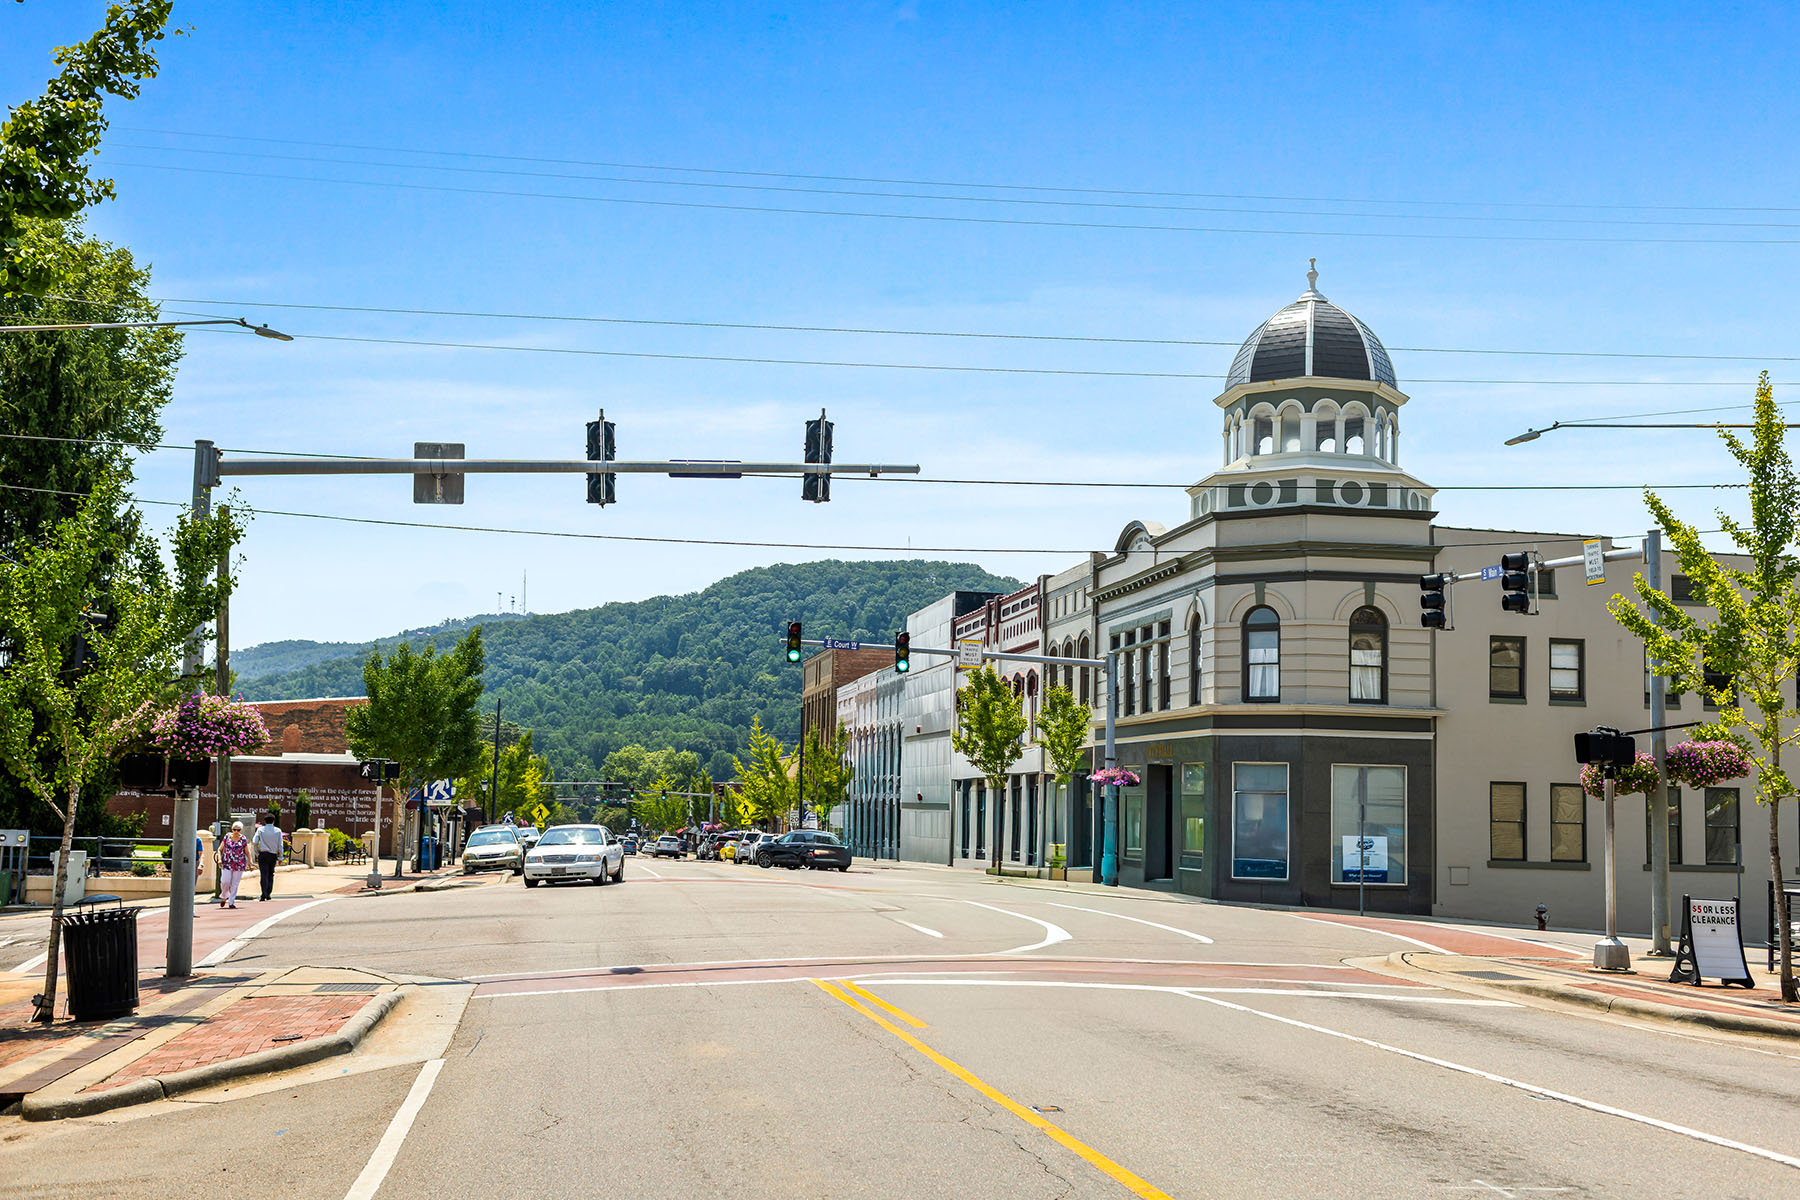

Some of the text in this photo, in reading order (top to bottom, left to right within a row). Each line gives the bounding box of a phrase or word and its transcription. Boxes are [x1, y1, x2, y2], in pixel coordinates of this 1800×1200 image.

[1488, 567, 1498, 578] Main
[834, 640, 850, 649] Court
[1692, 905, 1735, 915] $5 OR LESS
[1692, 915, 1735, 925] CLEARANCE
